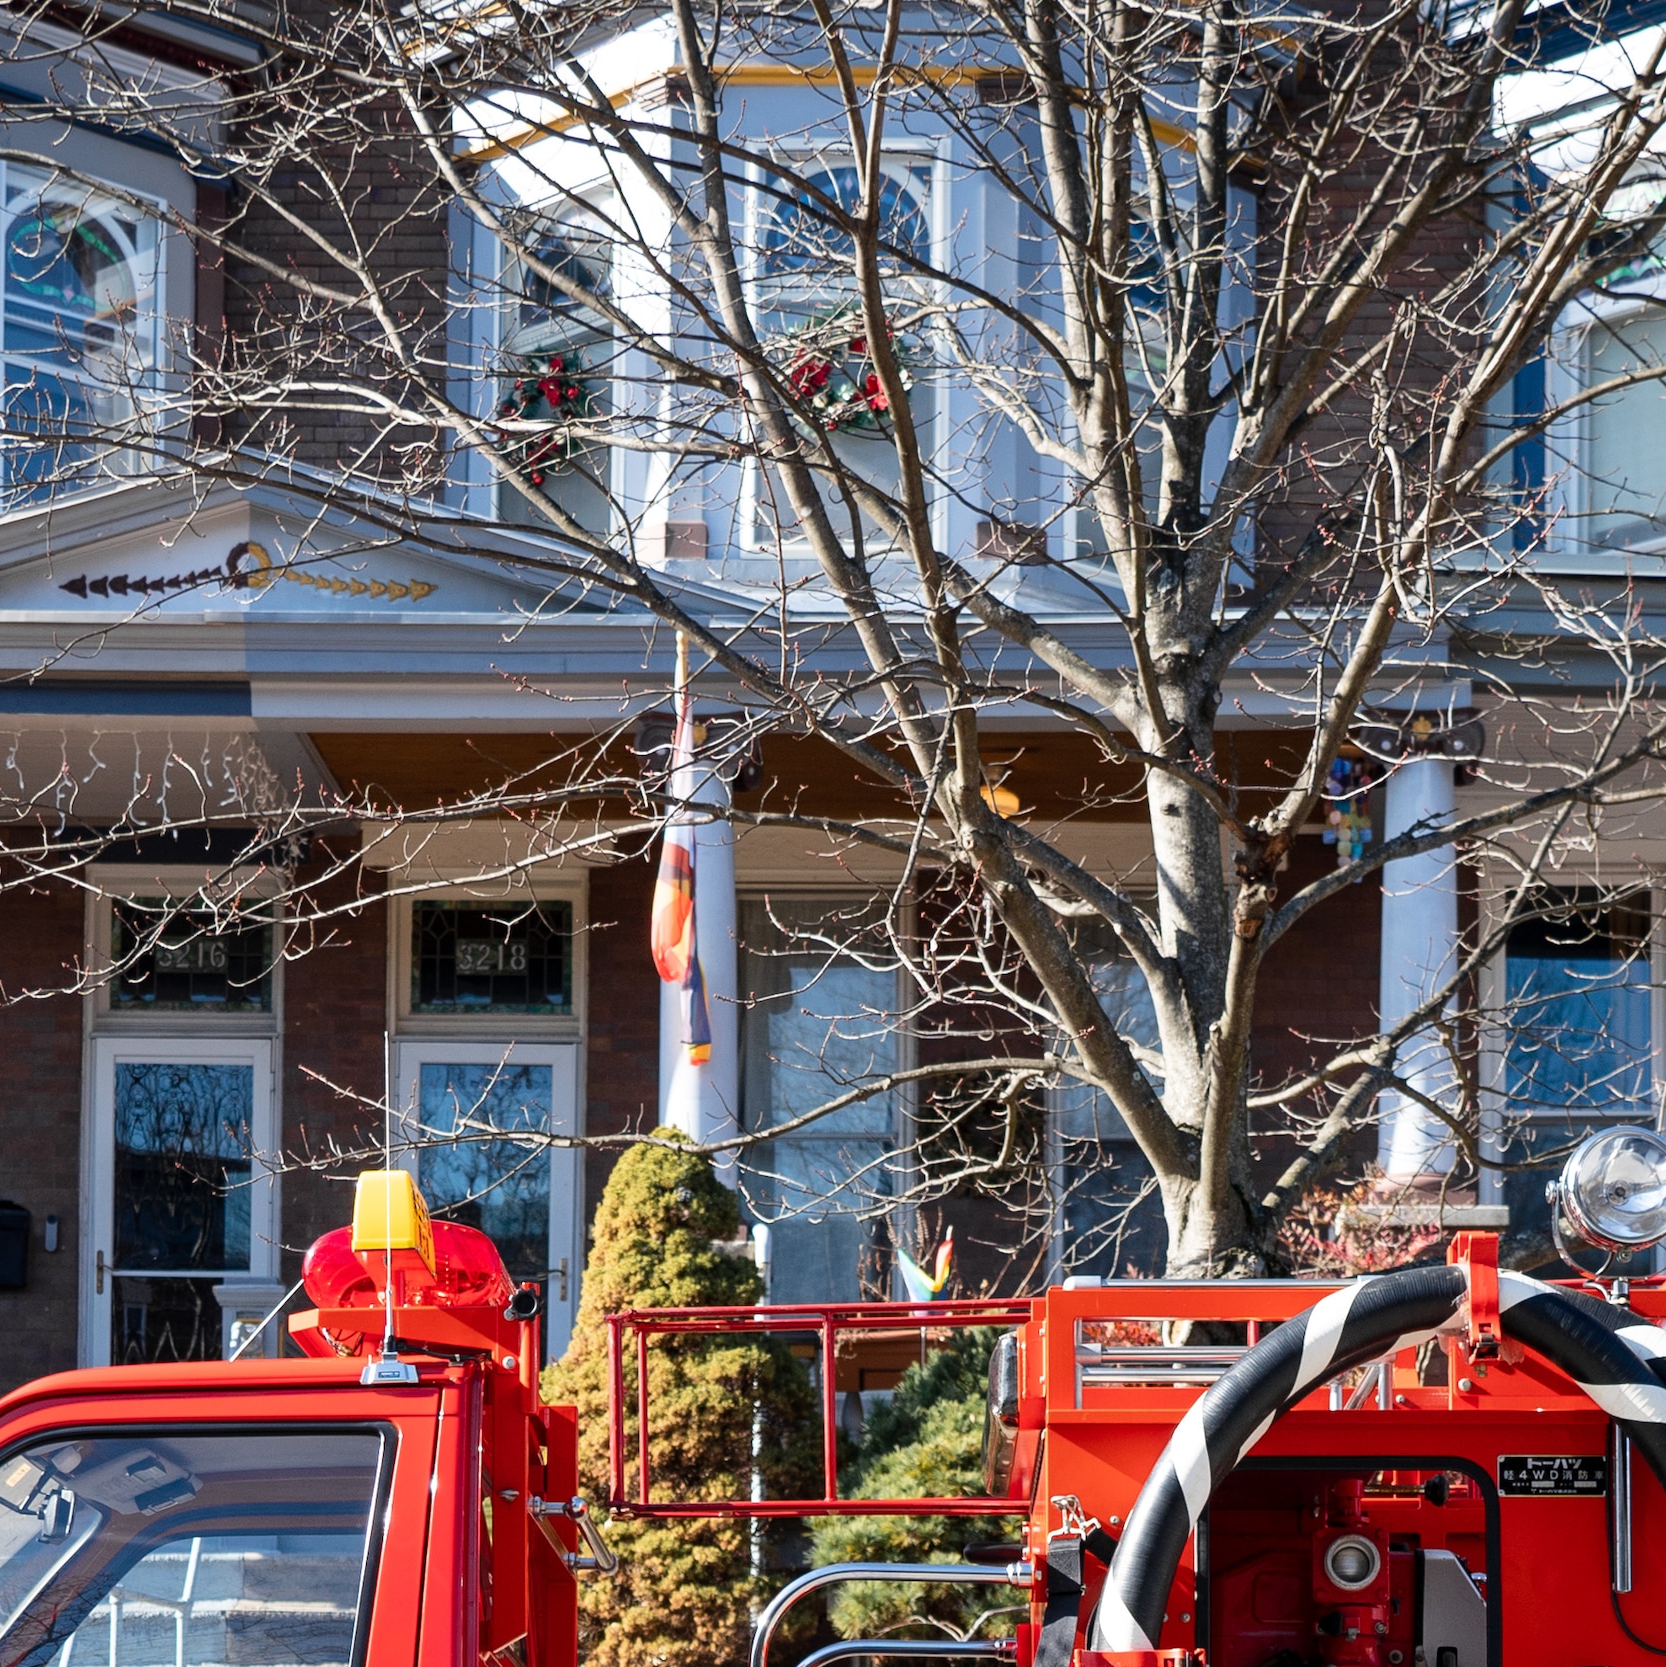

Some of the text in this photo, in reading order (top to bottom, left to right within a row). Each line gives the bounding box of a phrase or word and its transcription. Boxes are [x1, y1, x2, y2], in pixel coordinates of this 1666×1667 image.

[459, 943, 526, 971] 3218
[1527, 1458, 1582, 1470] トーハツ
